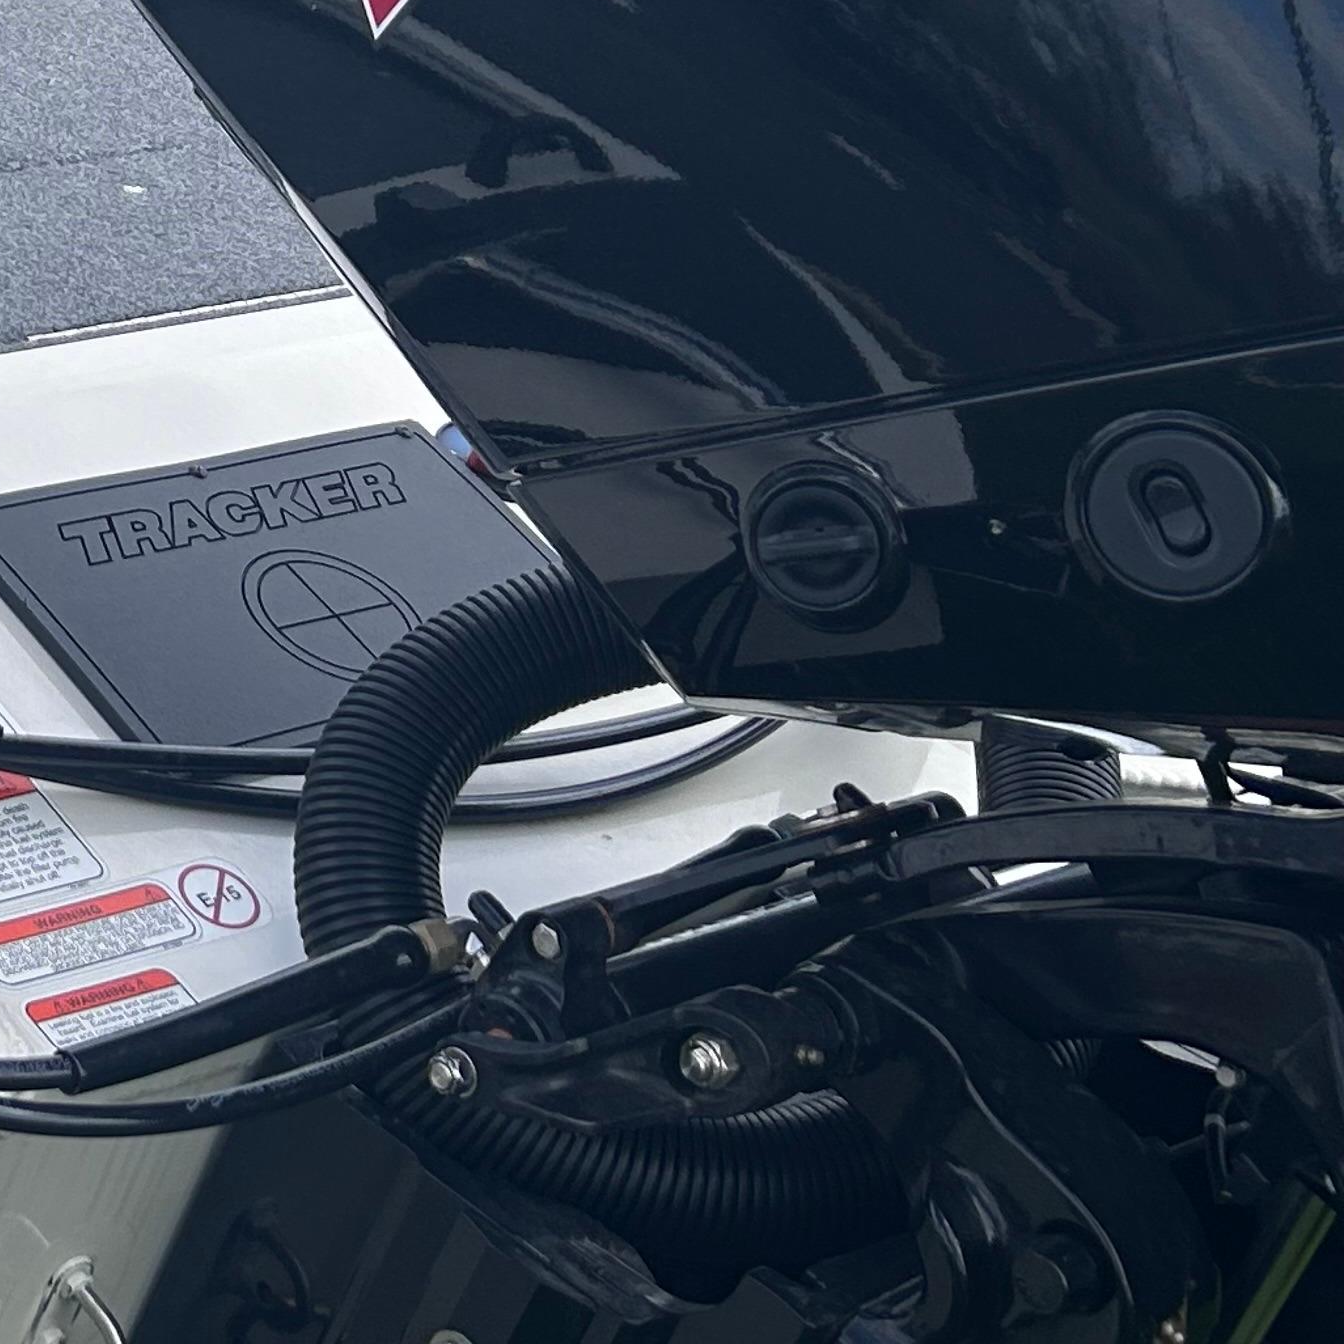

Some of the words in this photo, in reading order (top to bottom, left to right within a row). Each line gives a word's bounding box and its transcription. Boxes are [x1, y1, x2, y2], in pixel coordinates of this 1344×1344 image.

[58, 462, 407, 567] TRACKER
[3, 802, 30, 815] death
[12, 820, 46, 835] caused
[31, 827, 64, 841] system
[34, 904, 102, 929] WARNING
[67, 984, 136, 1008] WARNING
